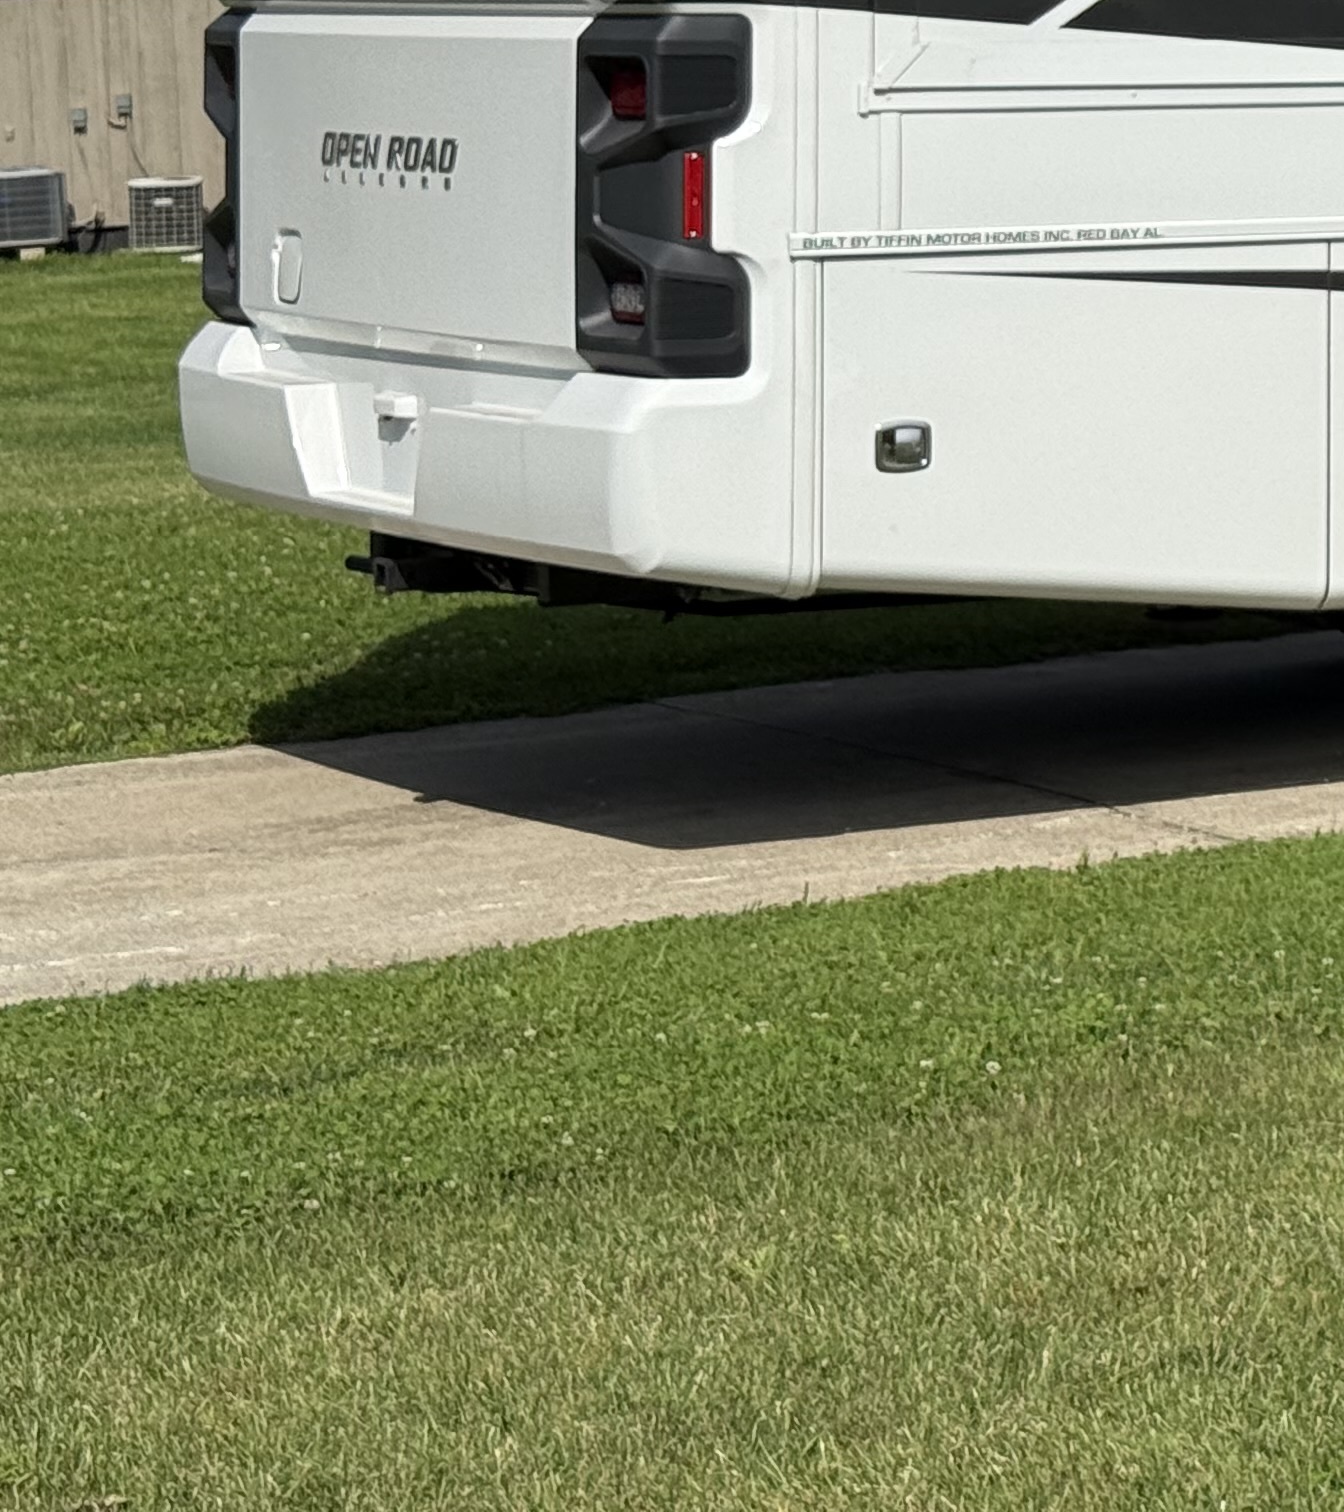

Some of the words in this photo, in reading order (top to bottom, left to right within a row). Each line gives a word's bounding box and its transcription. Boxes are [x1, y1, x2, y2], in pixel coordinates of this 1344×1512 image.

[321, 131, 382, 170] OPEN
[386, 135, 459, 173] ROAD
[802, 237, 848, 249] BUILT
[851, 236, 872, 248] BY
[876, 234, 922, 247] TIFFIN
[927, 232, 982, 246] MOTOR
[986, 231, 1040, 244] HOMES
[1077, 228, 1106, 241] RED
[1110, 227, 1140, 240] BAY
